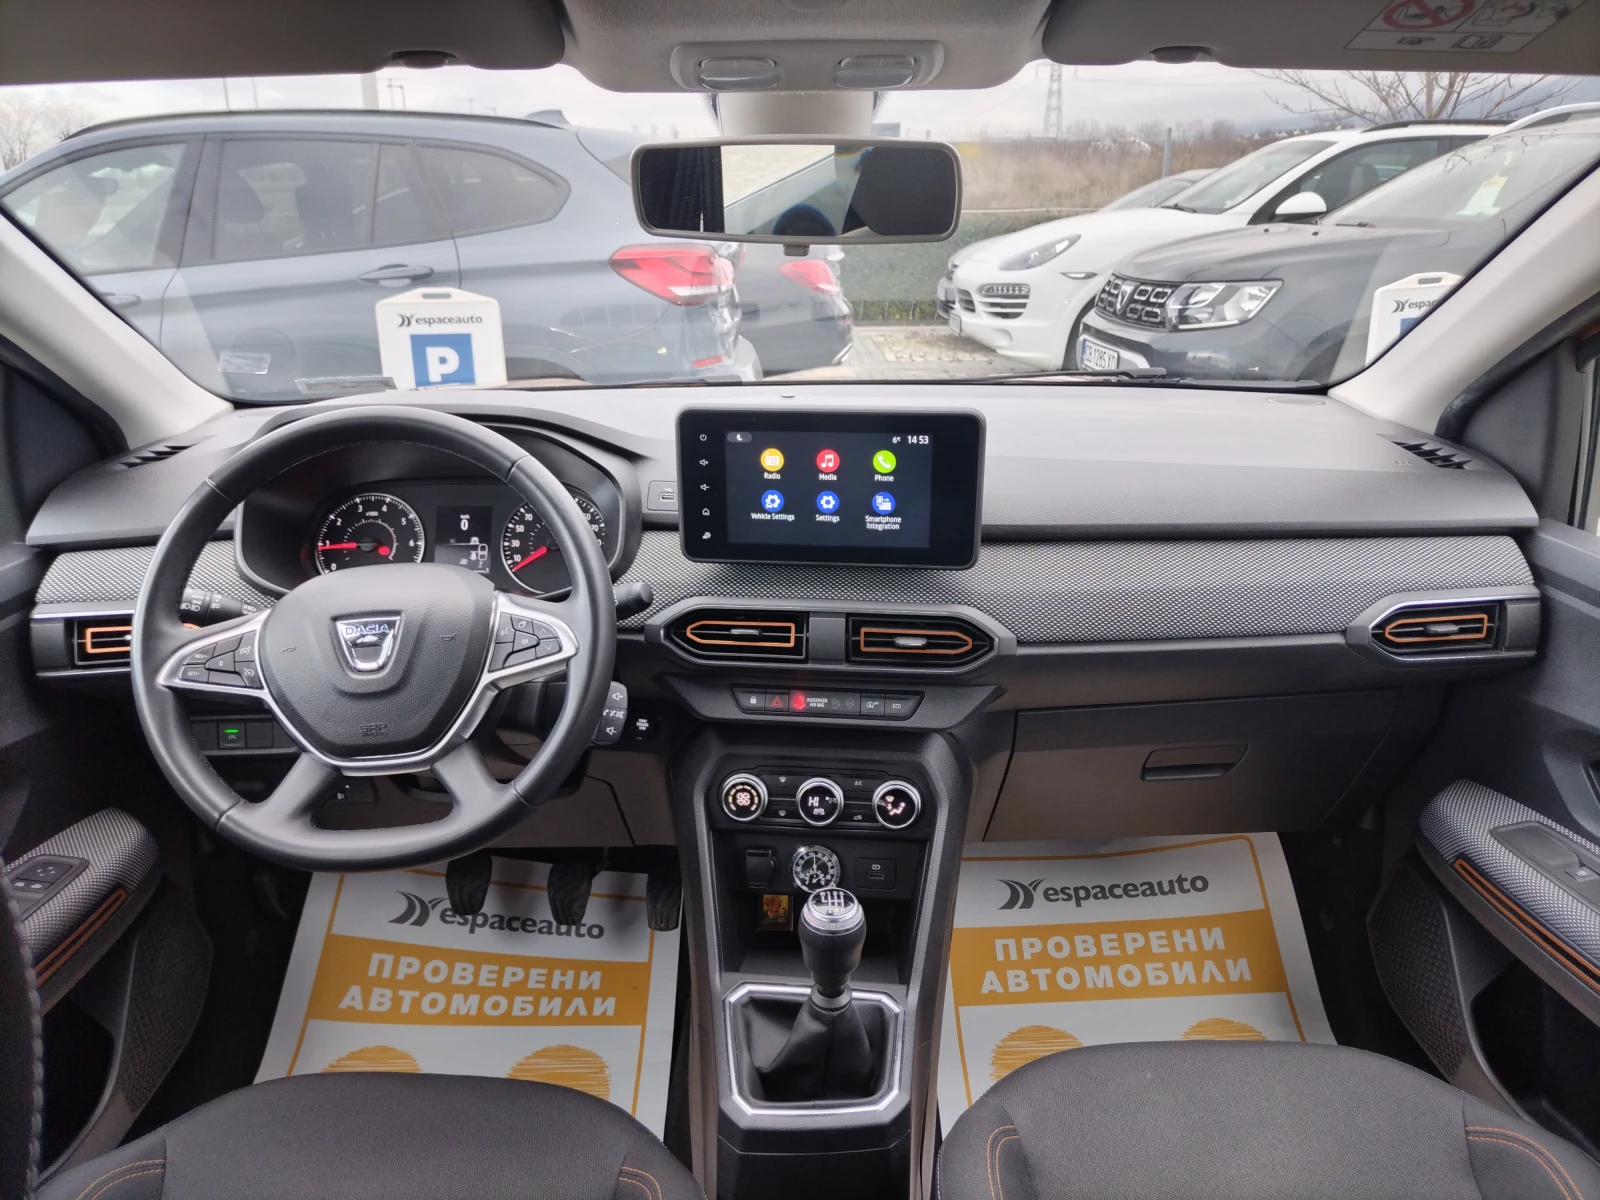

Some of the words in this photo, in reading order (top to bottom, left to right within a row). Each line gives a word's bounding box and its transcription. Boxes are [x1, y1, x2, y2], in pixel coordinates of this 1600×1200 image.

[415, 314, 483, 327] espaceauto
[425, 346, 460, 383] P
[764, 472, 781, 480] Radio
[818, 473, 837, 481] Media
[874, 474, 894, 482] Phone
[751, 512, 771, 520] Vehicle
[772, 513, 795, 521] Settings
[816, 514, 840, 522] Settings
[865, 515, 902, 524] Smartphone
[336, 518, 342, 526] 2
[460, 519, 469, 531] 0
[866, 522, 900, 530] Integration
[515, 524, 525, 532] 50
[408, 539, 414, 547] 6
[513, 554, 521, 562] 10
[345, 624, 390, 635] DACIA
[1042, 872, 1210, 908] espaceauto
[995, 926, 1226, 961] ПРОВЕРЕНИ
[368, 952, 603, 990] ПРОВЕРЕНИ
[981, 958, 1252, 994] АВТОМОБИЛИ
[338, 986, 616, 1016] АВТОМОБИЛИ
